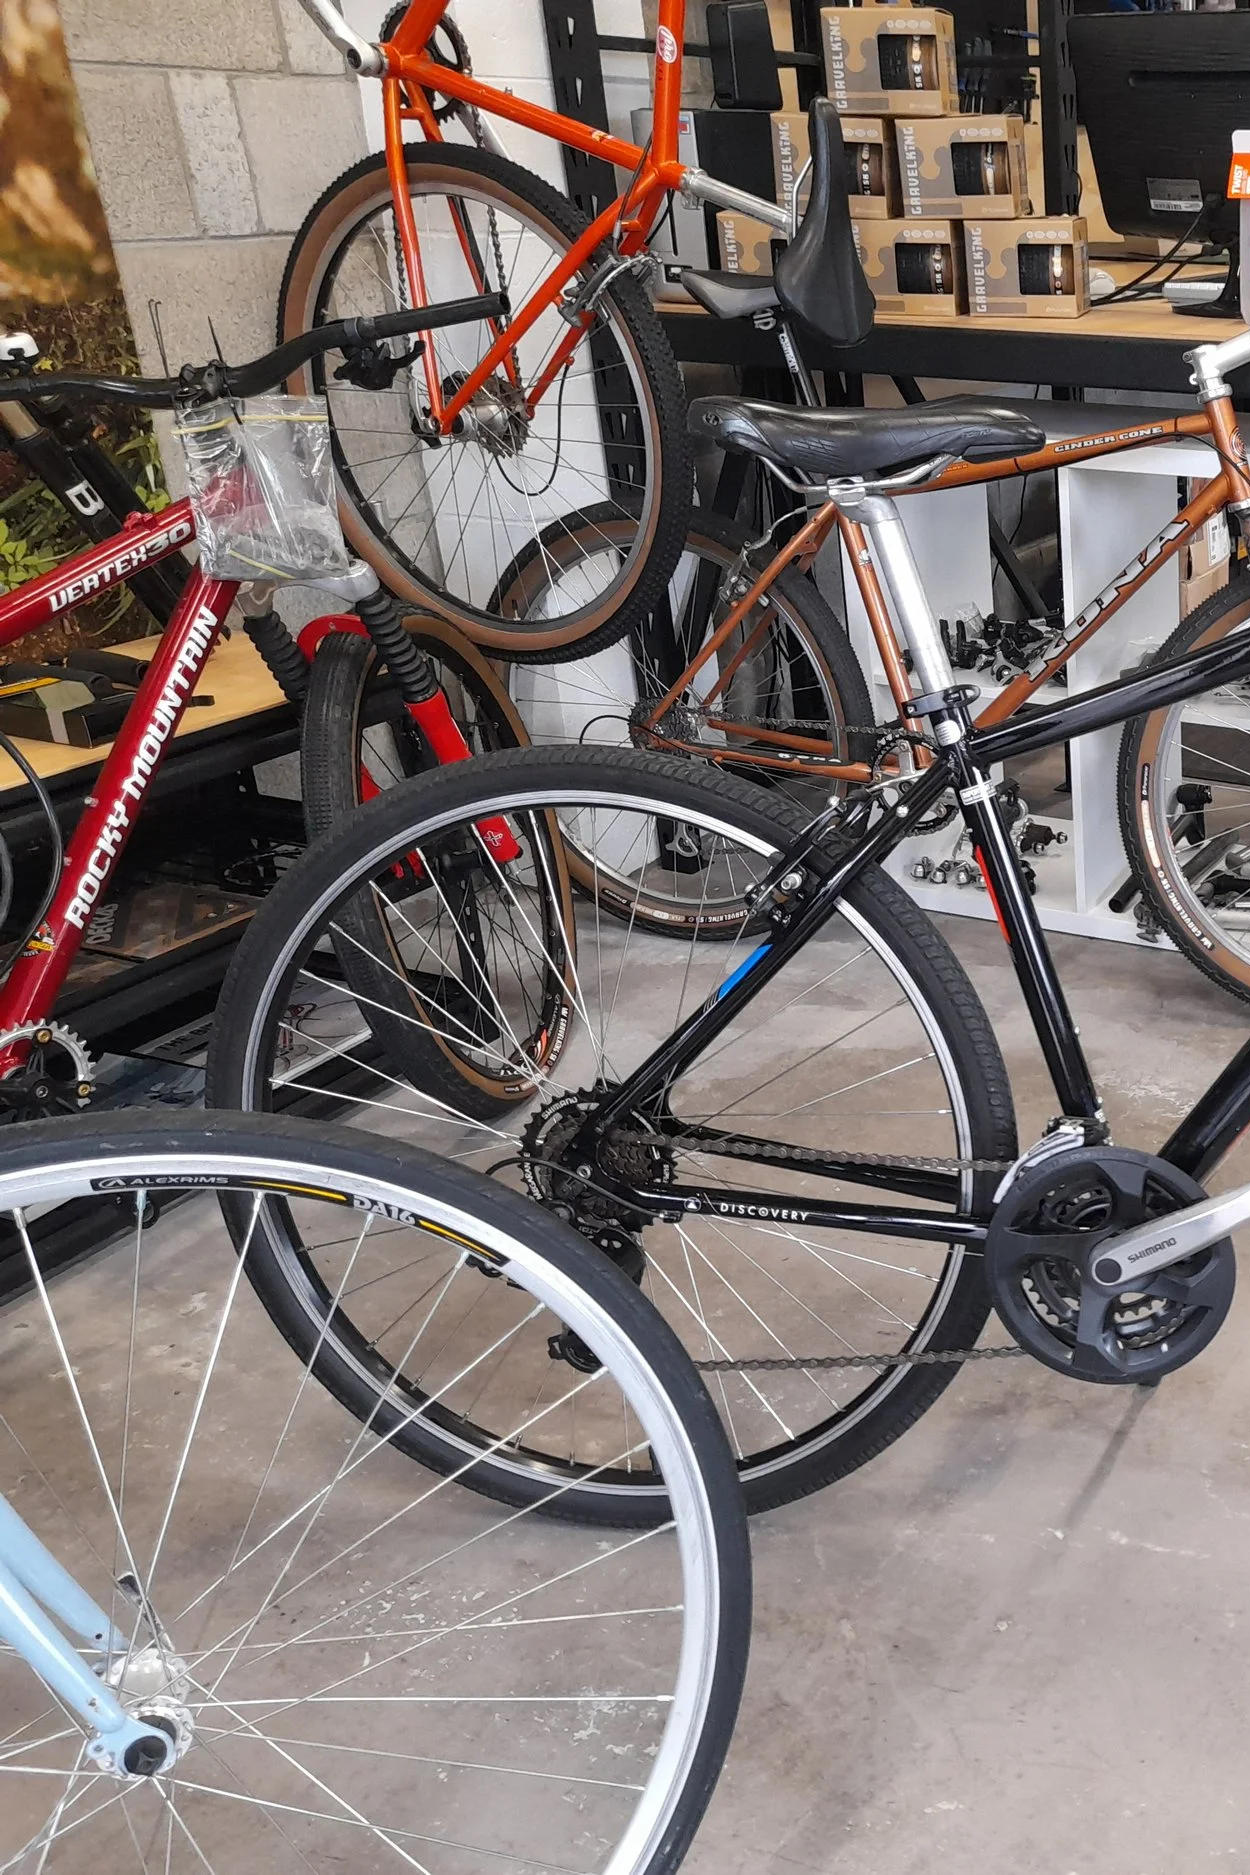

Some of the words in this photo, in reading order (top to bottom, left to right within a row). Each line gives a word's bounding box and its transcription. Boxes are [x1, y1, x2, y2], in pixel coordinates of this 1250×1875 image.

[828, 15, 848, 111] GRAVELKING
[902, 126, 923, 215] GRAVELKING
[1231, 164, 1244, 195] TWIST
[971, 227, 988, 313] GRAVELKING
[1053, 434, 1117, 454] CINDER
[1118, 425, 1164, 442] CONE
[1024, 518, 1190, 683] KONA
[121, 605, 219, 801] MOUNTAIN
[63, 800, 131, 930] ROCKY
[541, 1096, 579, 1121] SHIMANO
[130, 1176, 229, 1186] ALEXRIMS
[522, 1151, 544, 1201] MEGARANE
[353, 1195, 416, 1225] DA16
[719, 1201, 809, 1222] DISCOVERY
[1127, 1237, 1178, 1265] SHIMANO
